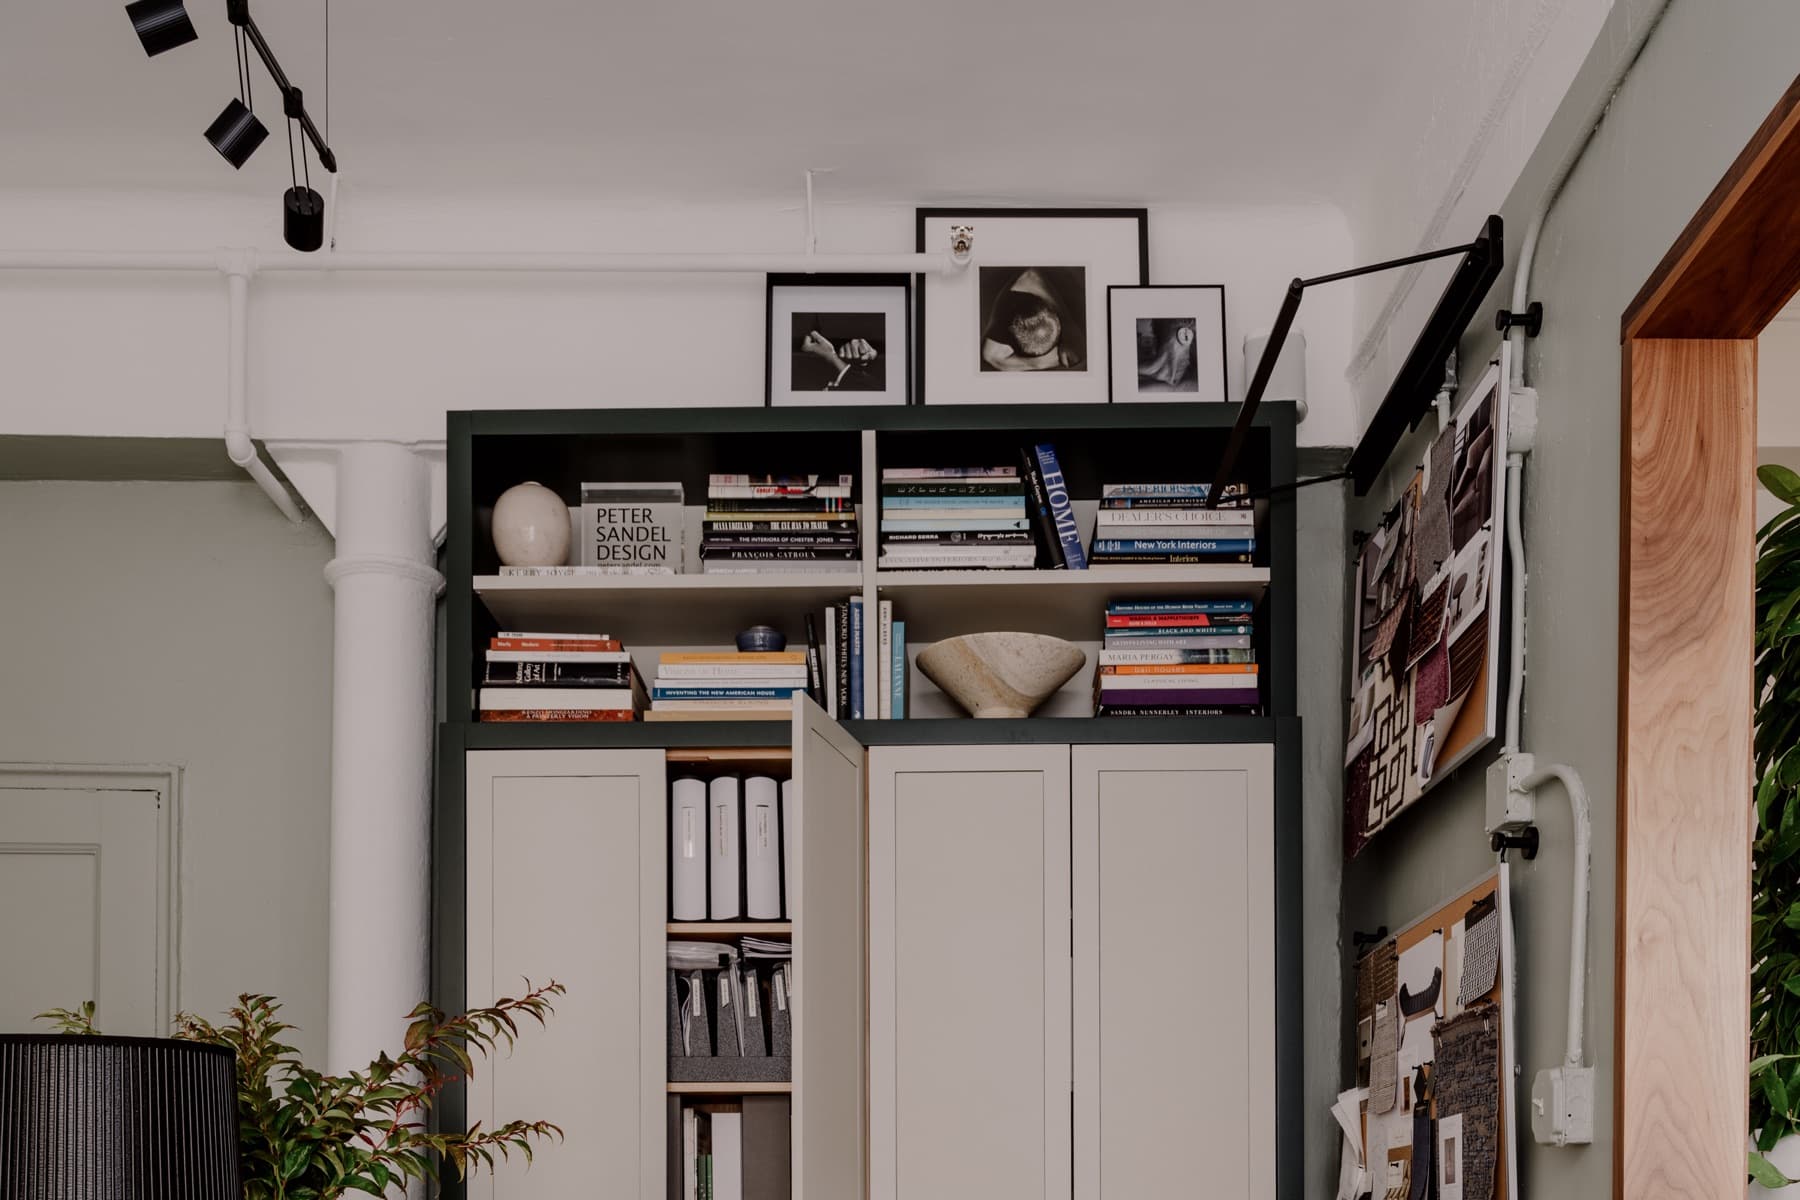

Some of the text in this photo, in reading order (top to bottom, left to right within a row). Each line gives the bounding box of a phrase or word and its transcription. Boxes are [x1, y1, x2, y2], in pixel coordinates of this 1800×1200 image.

[1043, 471, 1081, 547] HOME
[597, 508, 653, 524] PETER
[1111, 511, 1225, 522] DEALER'S CHOICE
[596, 526, 672, 542] SANDEL
[816, 536, 834, 544] JONES
[1134, 540, 1217, 550] New York Interiors
[597, 544, 667, 561] DESIGN
[731, 551, 817, 560] FRANÇOIS CATROUX
[1140, 653, 1174, 661] PERGAY
